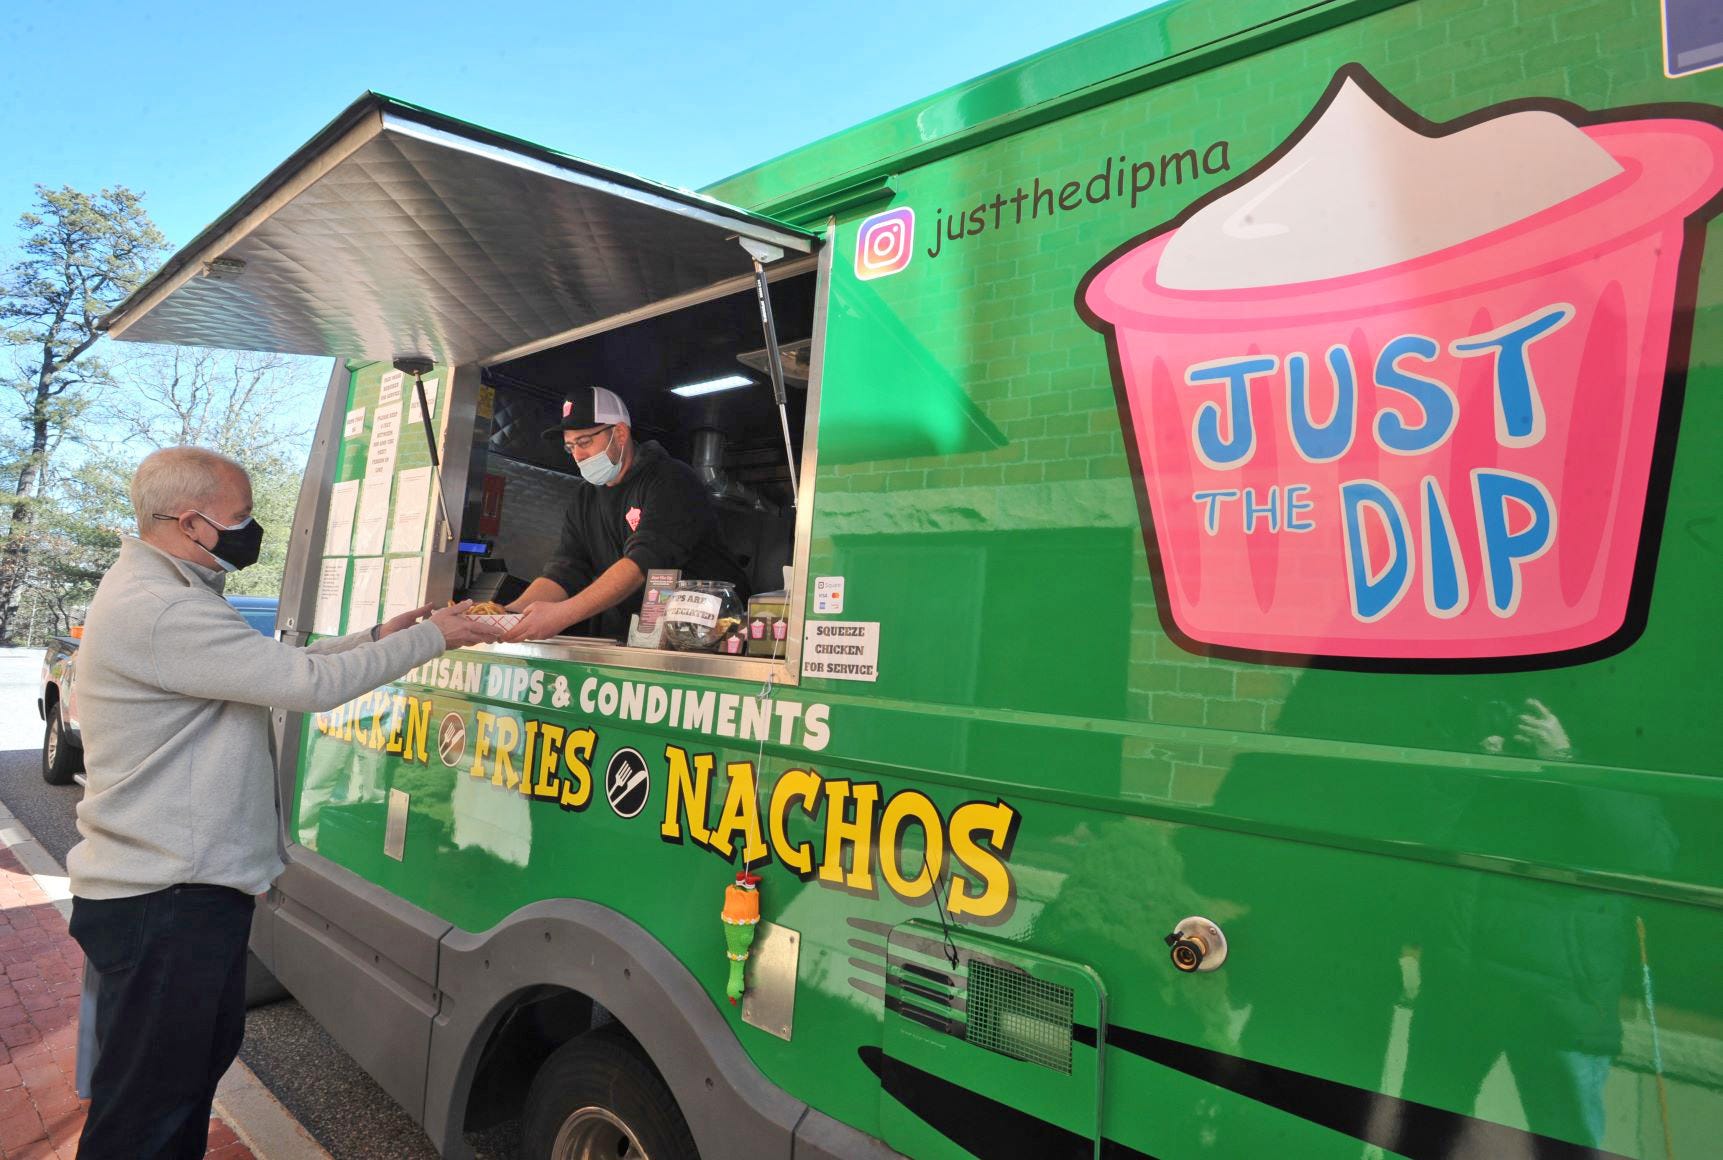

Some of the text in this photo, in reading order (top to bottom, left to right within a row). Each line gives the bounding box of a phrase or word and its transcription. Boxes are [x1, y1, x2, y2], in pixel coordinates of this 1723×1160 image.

[927, 140, 1231, 258] justthedipma
[1184, 302, 1576, 471] JUST
[1192, 468, 1559, 625] THE DIP
[804, 661, 874, 676] FOR SERVICE
[815, 644, 865, 656] CHICKEN
[816, 626, 866, 637] SQUEEZE
[487, 665, 544, 705] DIPS
[552, 677, 571, 708] &
[580, 677, 831, 752] CONDIMENTS
[470, 710, 598, 811] FRIES
[661, 744, 1019, 921] NACHOS
